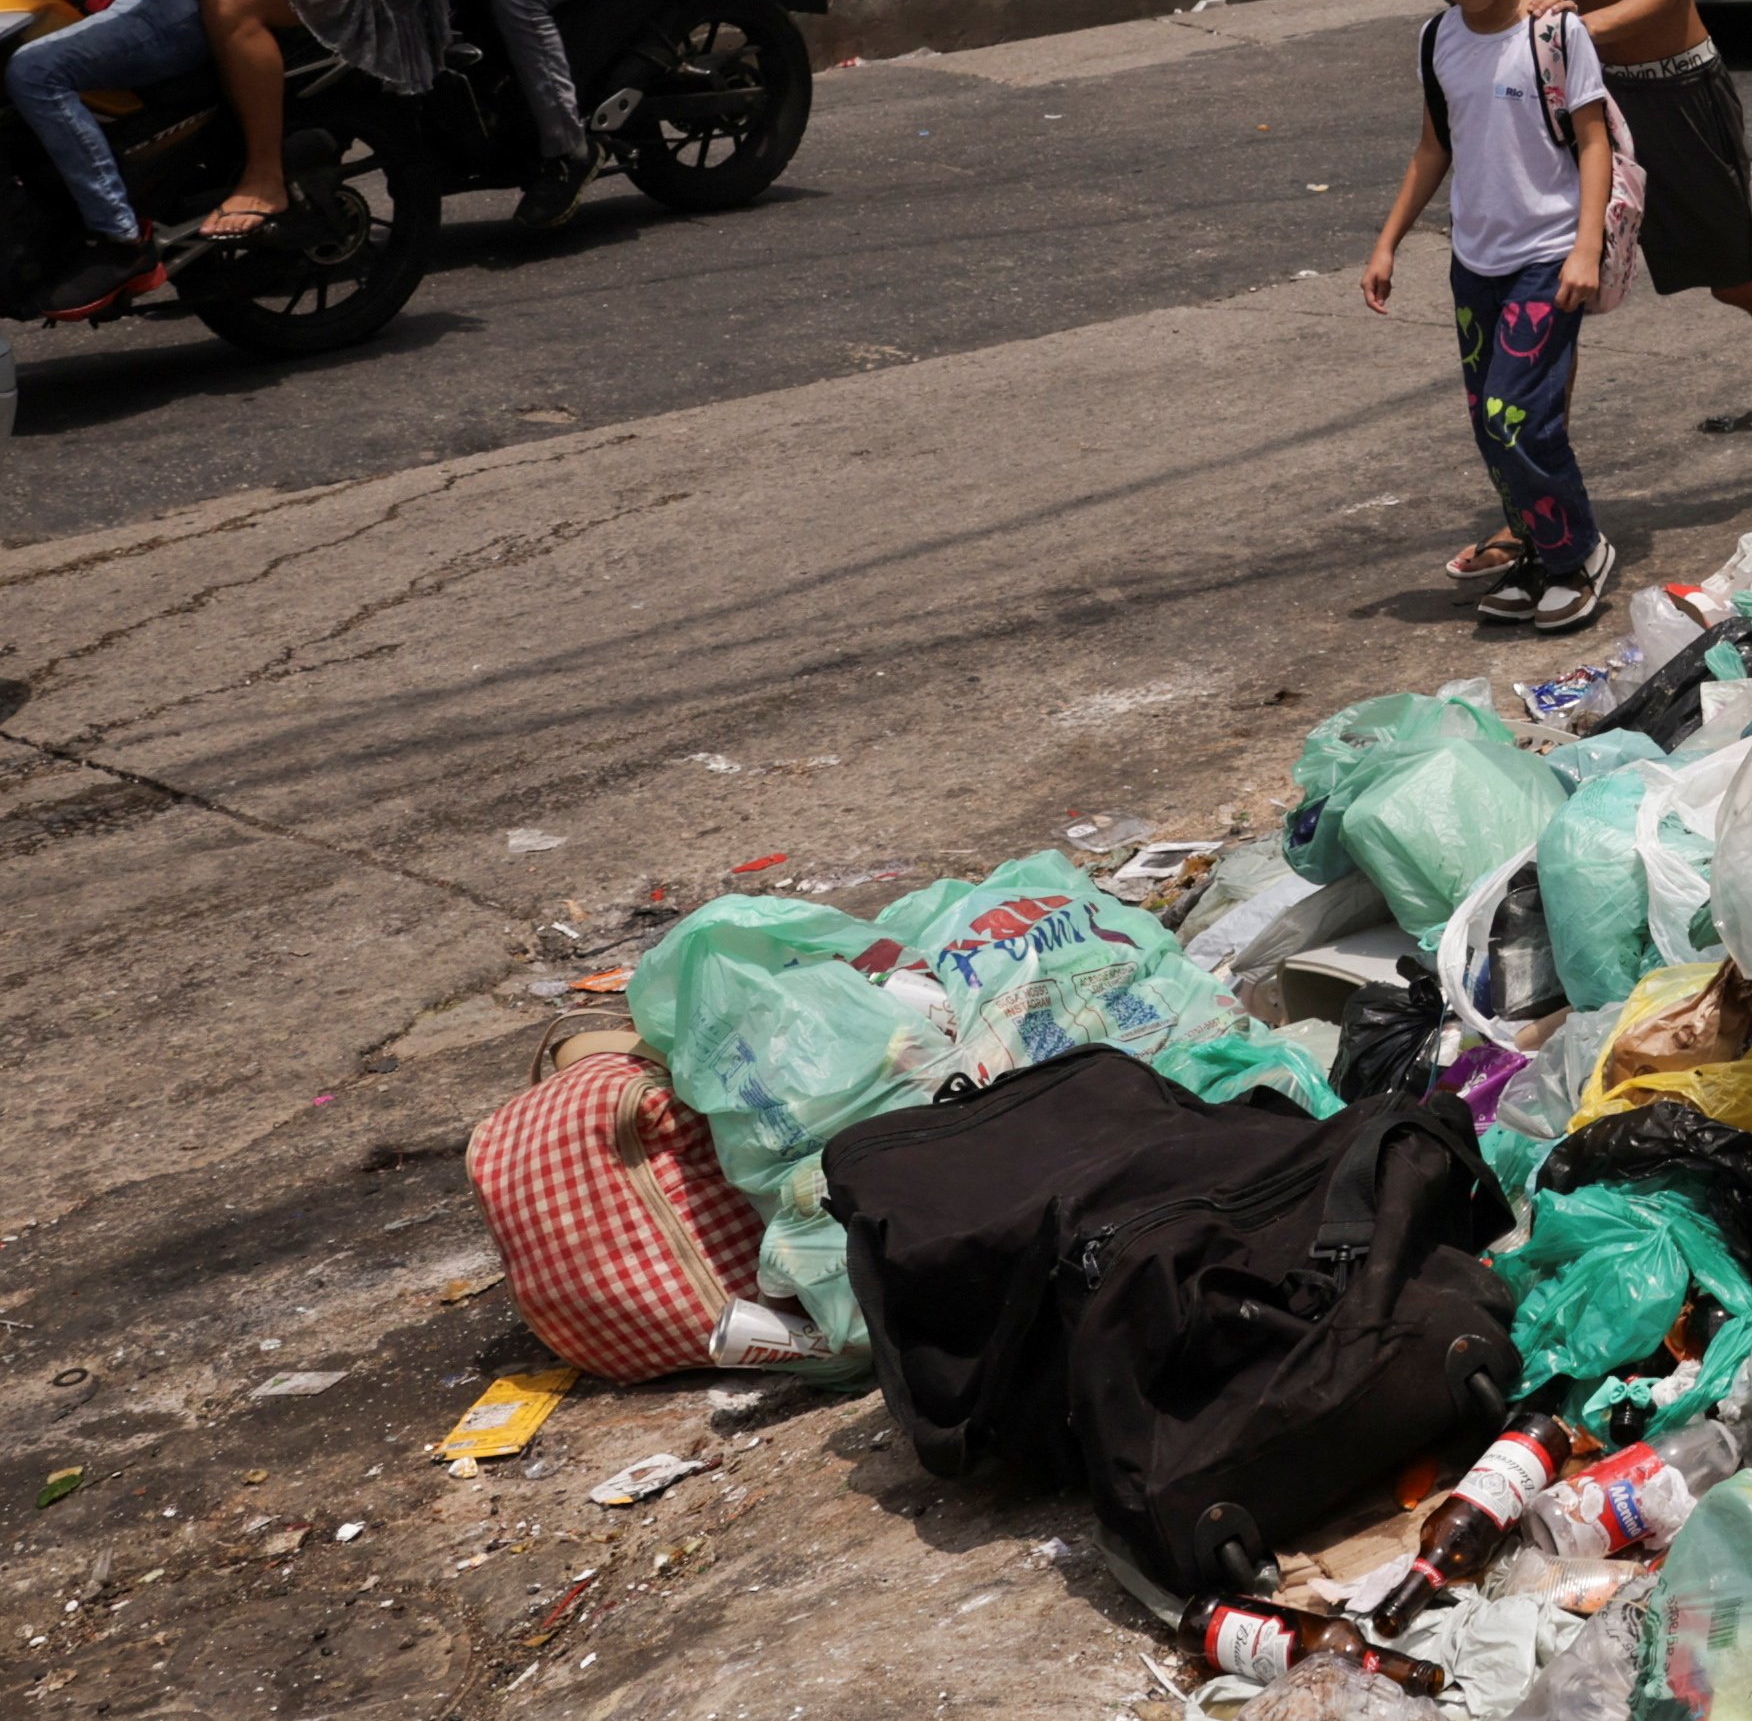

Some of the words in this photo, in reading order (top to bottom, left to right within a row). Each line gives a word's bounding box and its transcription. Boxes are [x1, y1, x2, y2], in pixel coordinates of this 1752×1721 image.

[1659, 52, 1704, 77] Klein
[1504, 86, 1524, 98] Rio
[1609, 1482, 1645, 1540] Menino
